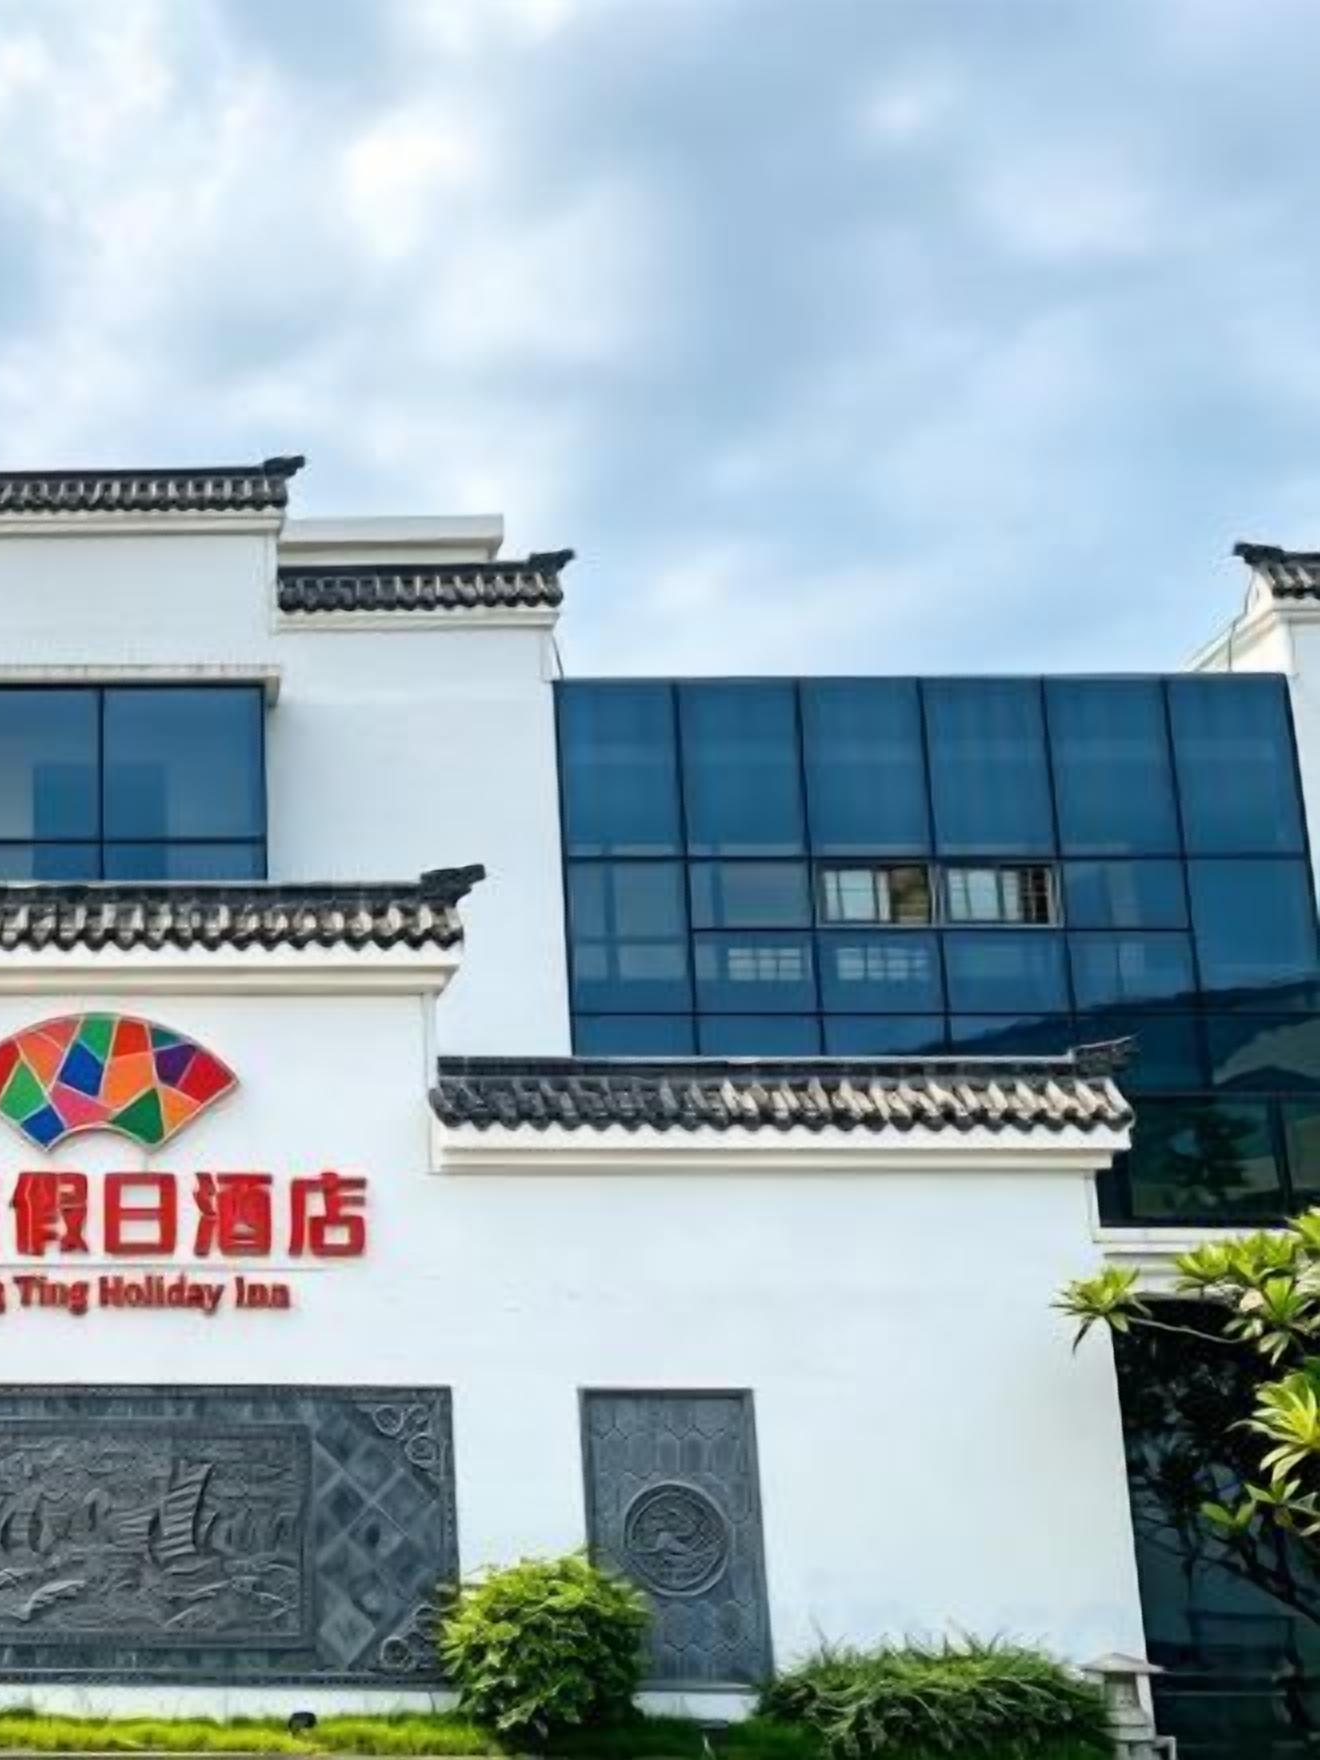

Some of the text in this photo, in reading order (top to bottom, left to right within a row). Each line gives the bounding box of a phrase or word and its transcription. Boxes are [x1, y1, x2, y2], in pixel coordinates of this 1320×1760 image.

[14, 1275, 89, 1316] Ting
[99, 1275, 225, 1315] Holiday
[236, 1276, 291, 1310] Inn
